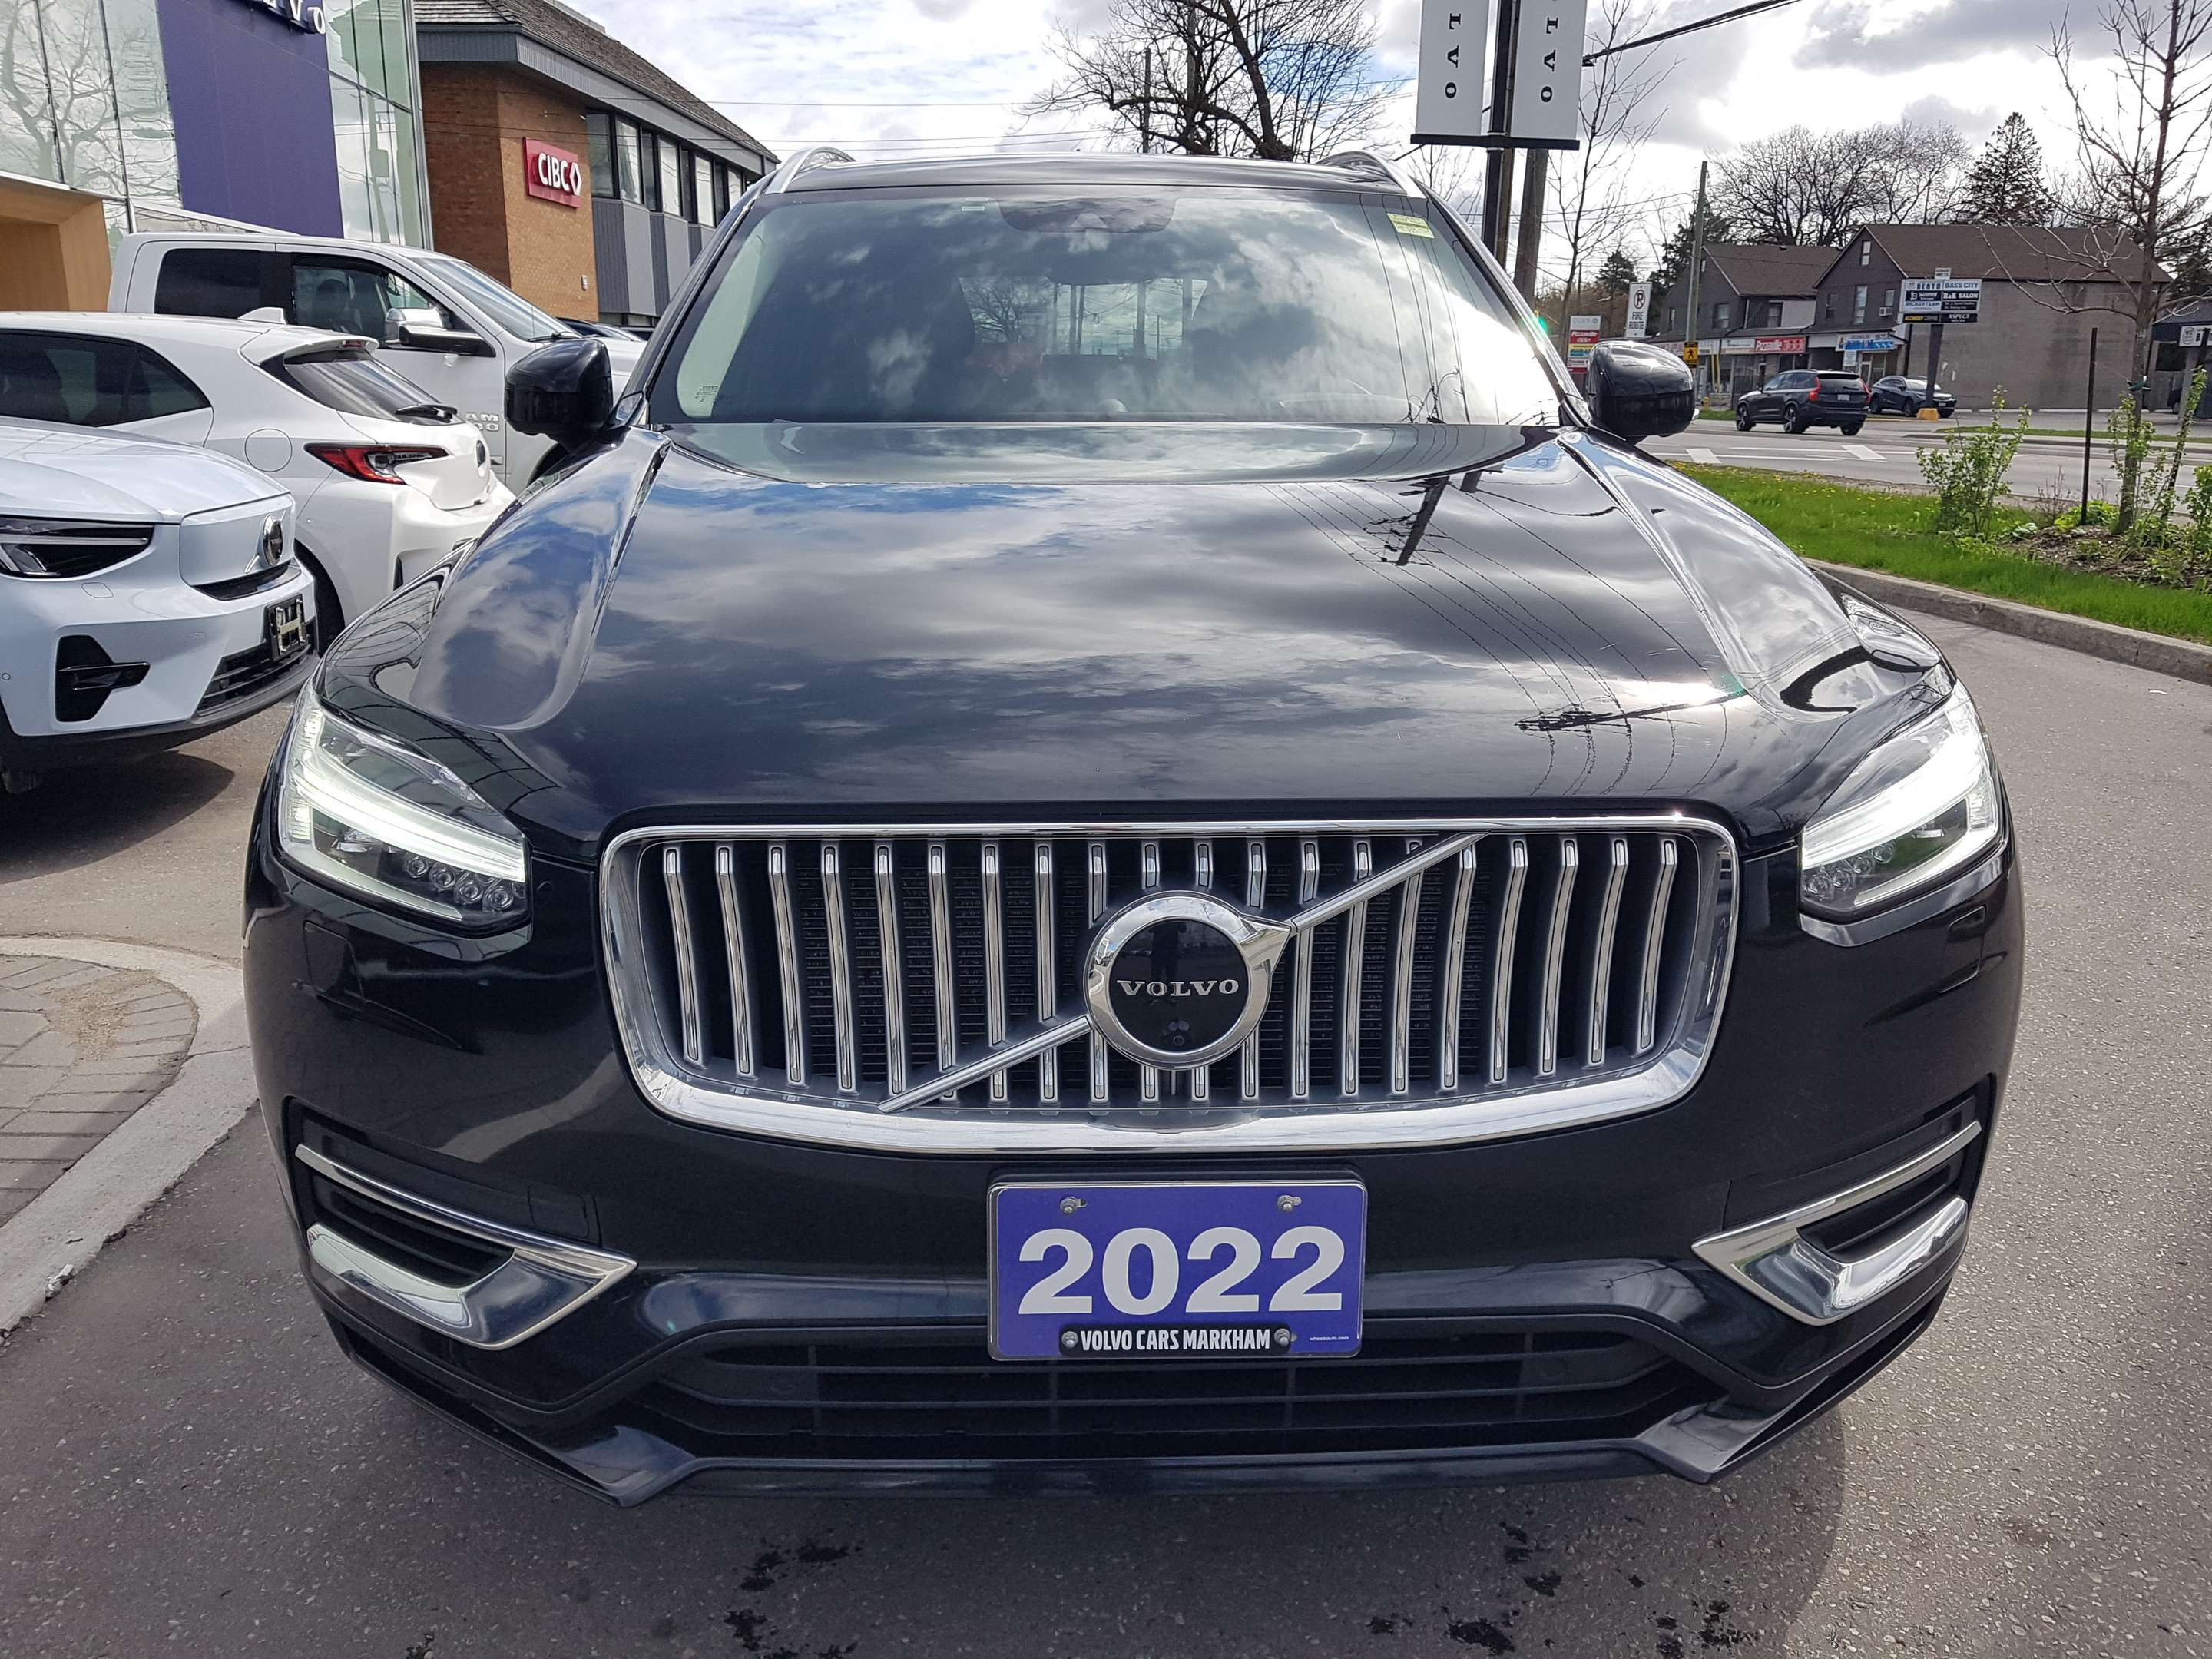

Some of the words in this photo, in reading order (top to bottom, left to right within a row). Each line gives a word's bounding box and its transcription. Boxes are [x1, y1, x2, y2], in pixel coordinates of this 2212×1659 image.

[538, 152, 570, 192] CIBC
[1117, 979, 1240, 998] VOLVO
[1018, 1225, 1346, 1316] 2022
[1081, 1330, 1133, 1350] VOLVO
[1136, 1330, 1180, 1350] CARS
[1183, 1329, 1271, 1350] MARKHAM
